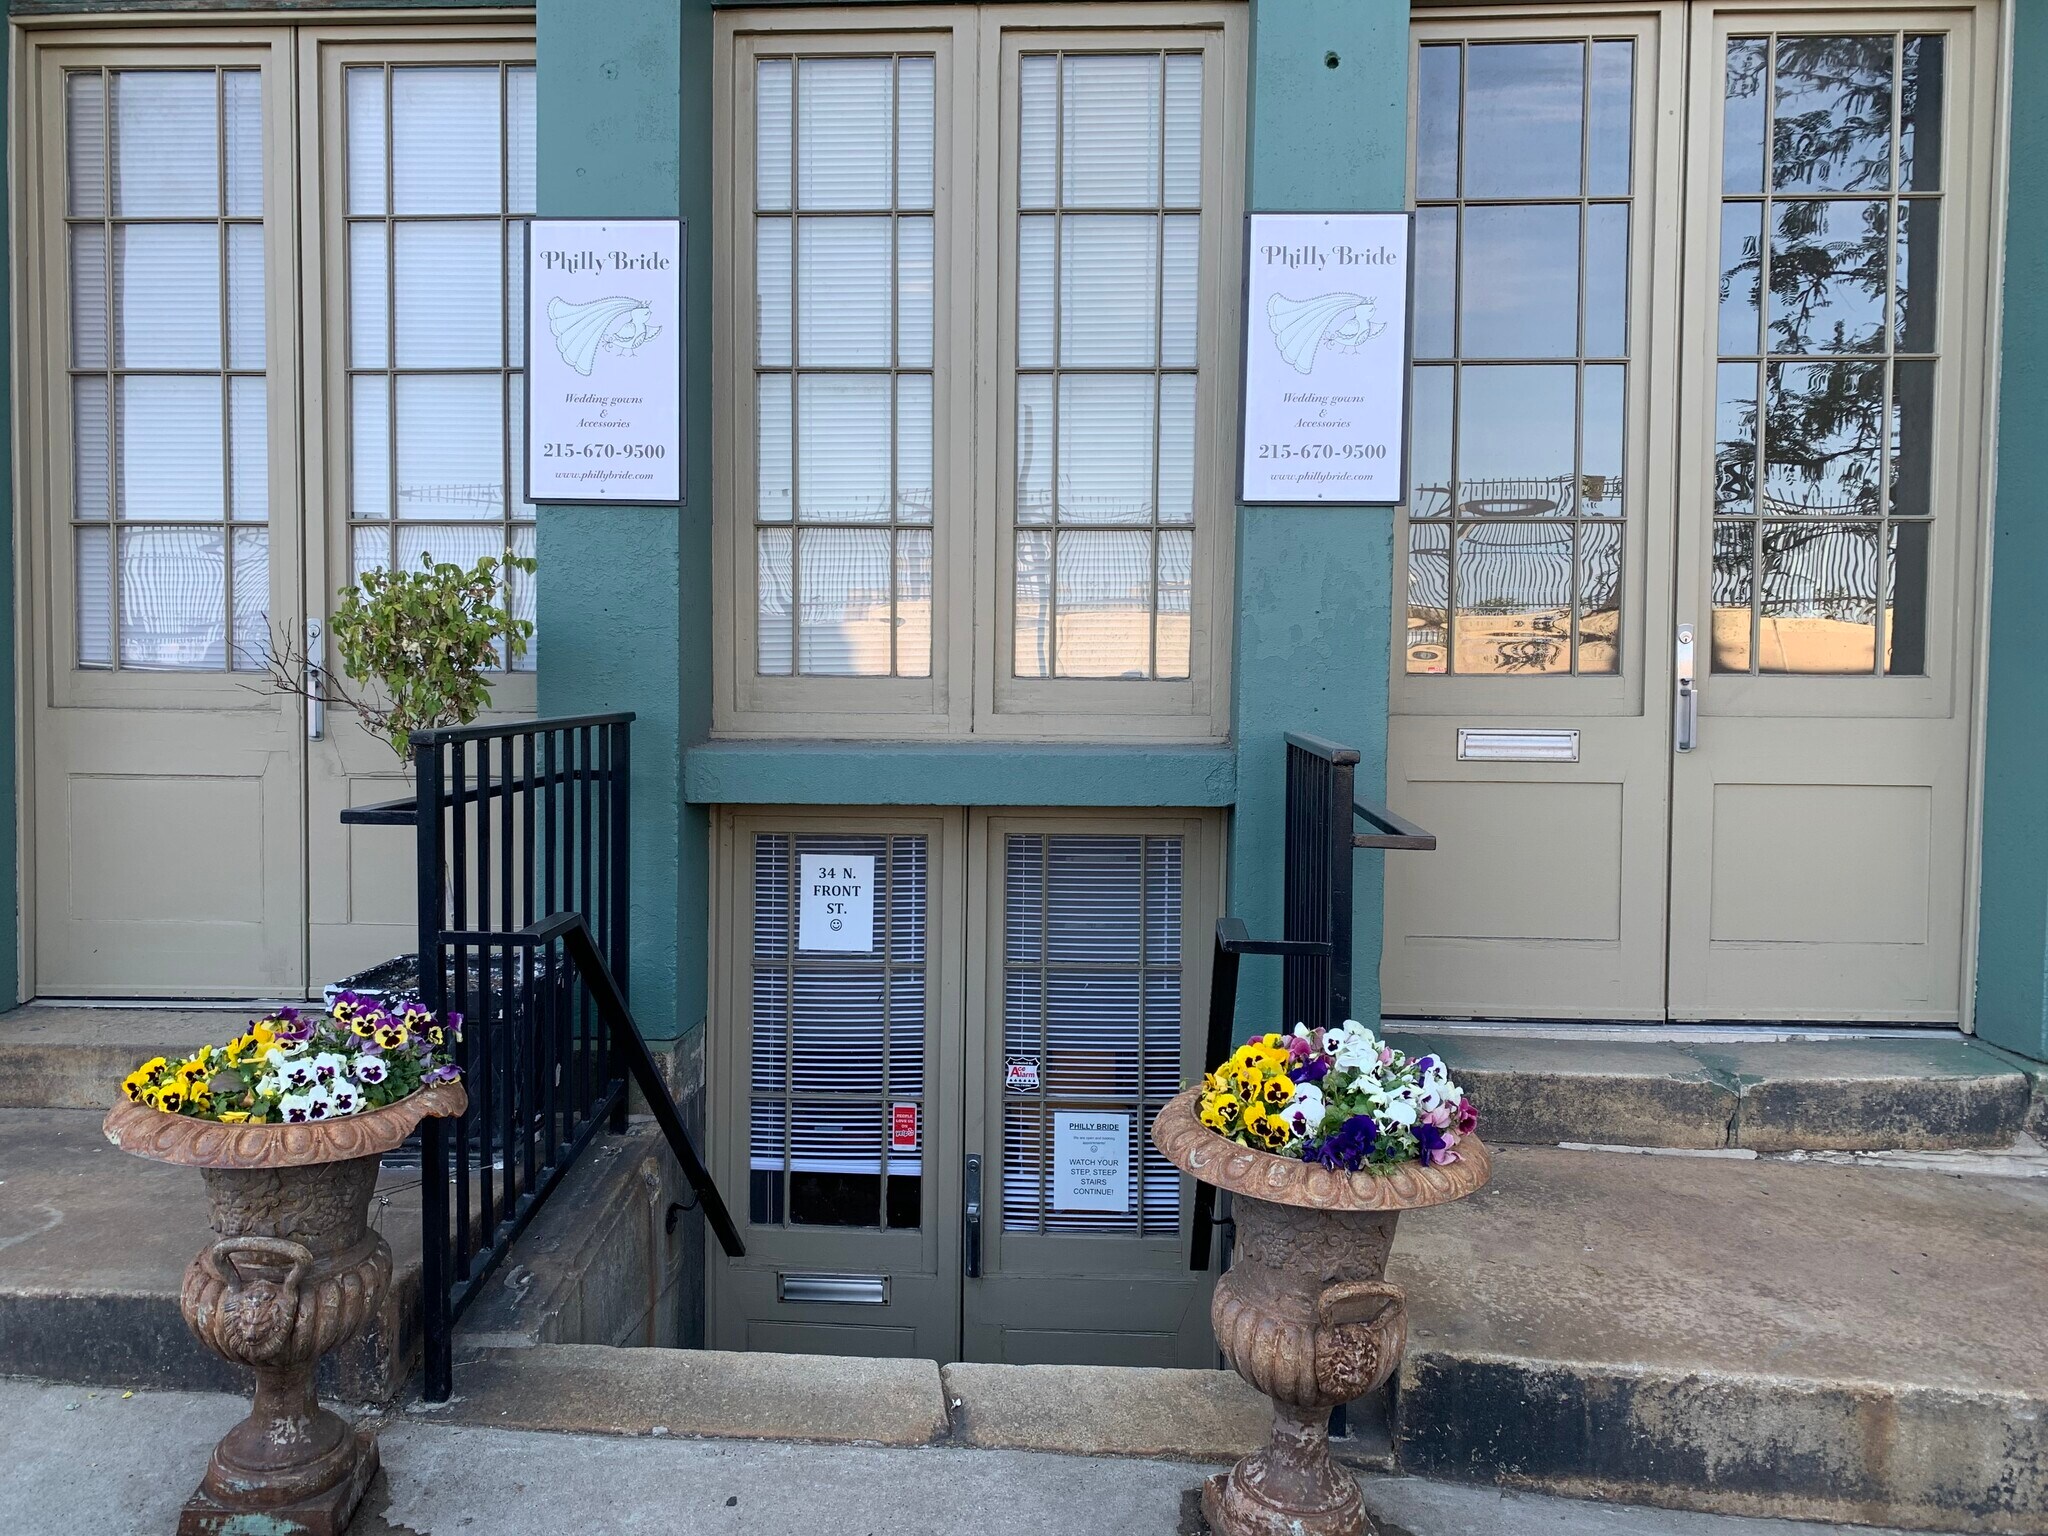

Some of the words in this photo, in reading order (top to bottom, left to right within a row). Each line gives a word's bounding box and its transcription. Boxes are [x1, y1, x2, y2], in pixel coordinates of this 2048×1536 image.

[540, 251, 606, 275] Philly
[608, 251, 670, 270] Bride
[1261, 246, 1330, 271] Philly
[1332, 246, 1397, 265] Bride
[565, 394, 608, 407] Wedding
[610, 396, 643, 407] gowns
[1283, 393, 1329, 406] Wedding
[1330, 396, 1365, 406] gowns
[599, 409, 608, 418] &
[1318, 409, 1328, 418] &
[576, 418, 631, 428] Accessories
[1294, 418, 1351, 428] Accessories
[543, 442, 665, 459] 215-670-9500
[1259, 444, 1386, 460] 215-670-9500
[555, 470, 654, 481] www.phillybride.com
[1270, 472, 1373, 484] www.phillybride.com
[819, 867, 836, 879] 34
[843, 868, 856, 879] N.
[813, 885, 861, 897] FRONT
[826, 903, 847, 914] ST.
[1096, 1123, 1119, 1131] BRIDE
[1097, 1159, 1119, 1167] YOUR
[1070, 1168, 1091, 1176] STEP,
[1080, 1178, 1107, 1186] STAIRS
[1073, 1188, 1114, 1196] CONTINUE!
